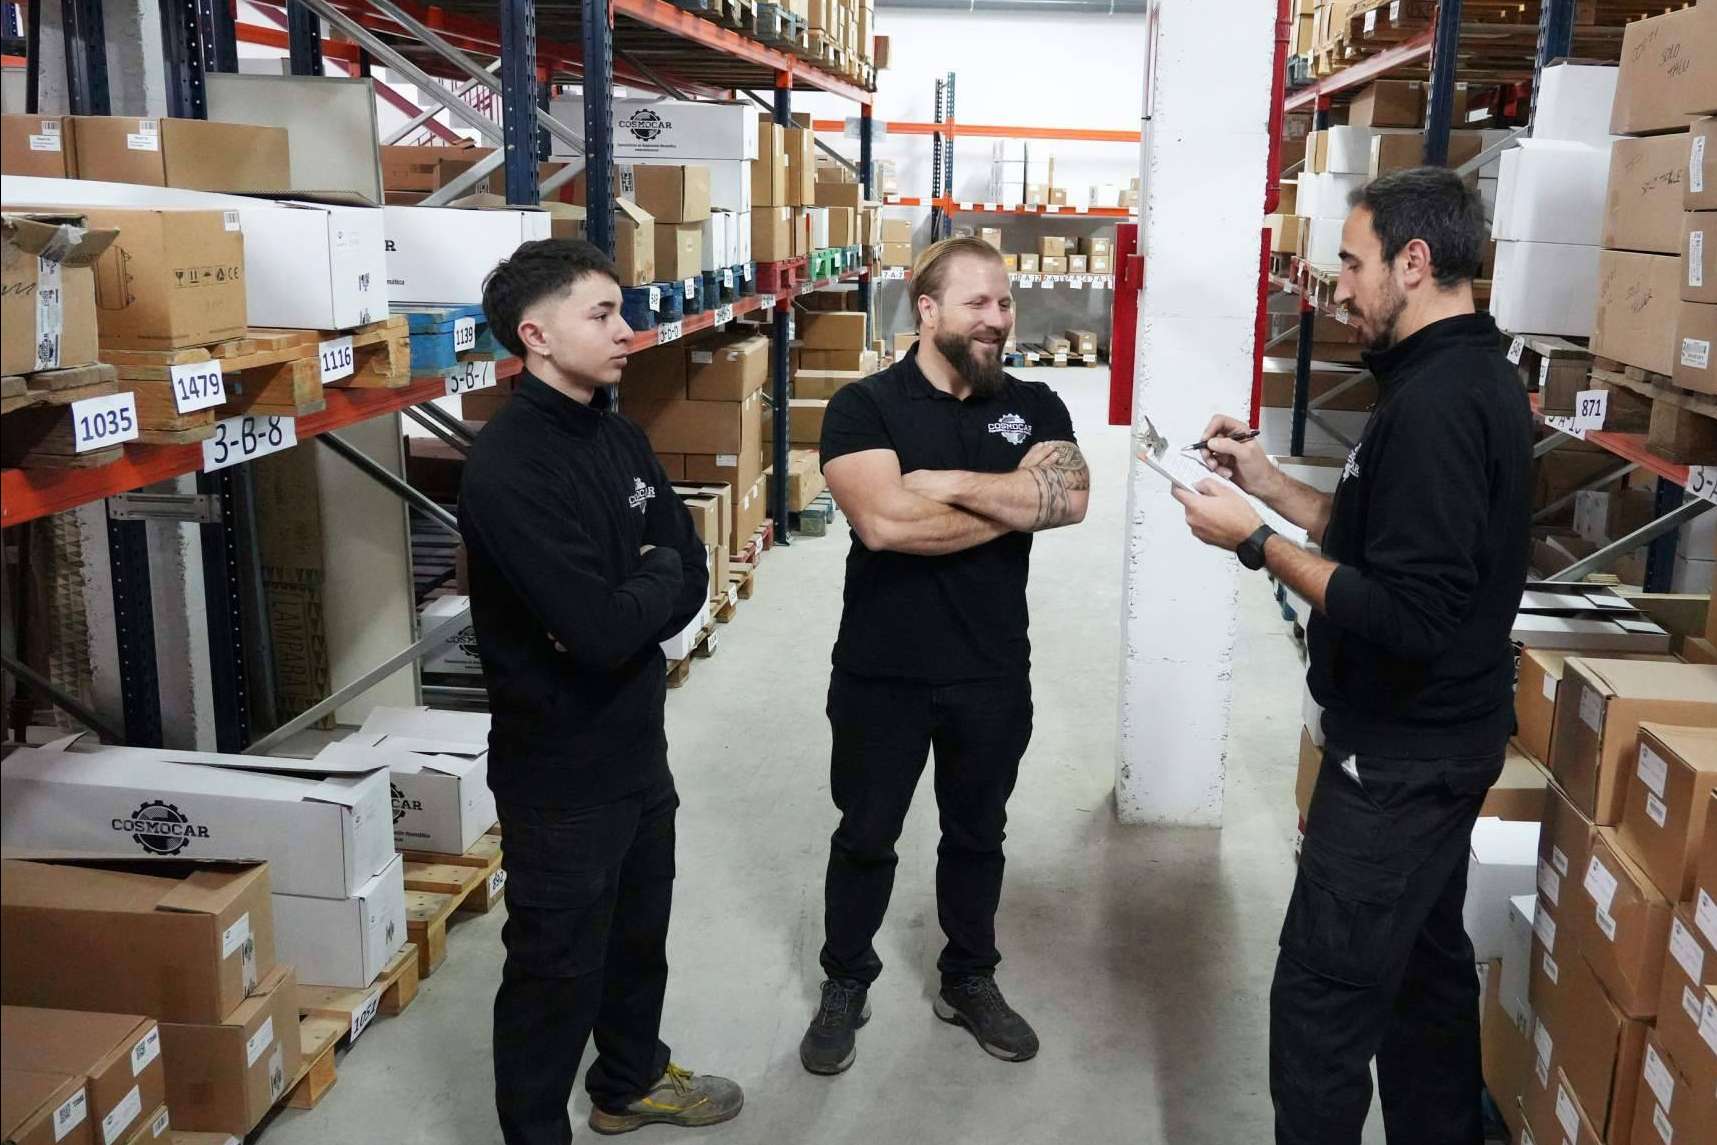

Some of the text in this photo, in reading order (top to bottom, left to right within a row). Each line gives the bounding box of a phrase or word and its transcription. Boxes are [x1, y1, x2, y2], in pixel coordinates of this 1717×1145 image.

[618, 120, 673, 129] COSMOCAR
[456, 326, 473, 346] 1139
[322, 347, 351, 372] 1116
[178, 373, 220, 400] 1479
[1581, 399, 1601, 417] 871
[80, 407, 132, 441] 1035
[214, 416, 282, 464] 3-B-8
[111, 819, 211, 838] COSMOCAR
